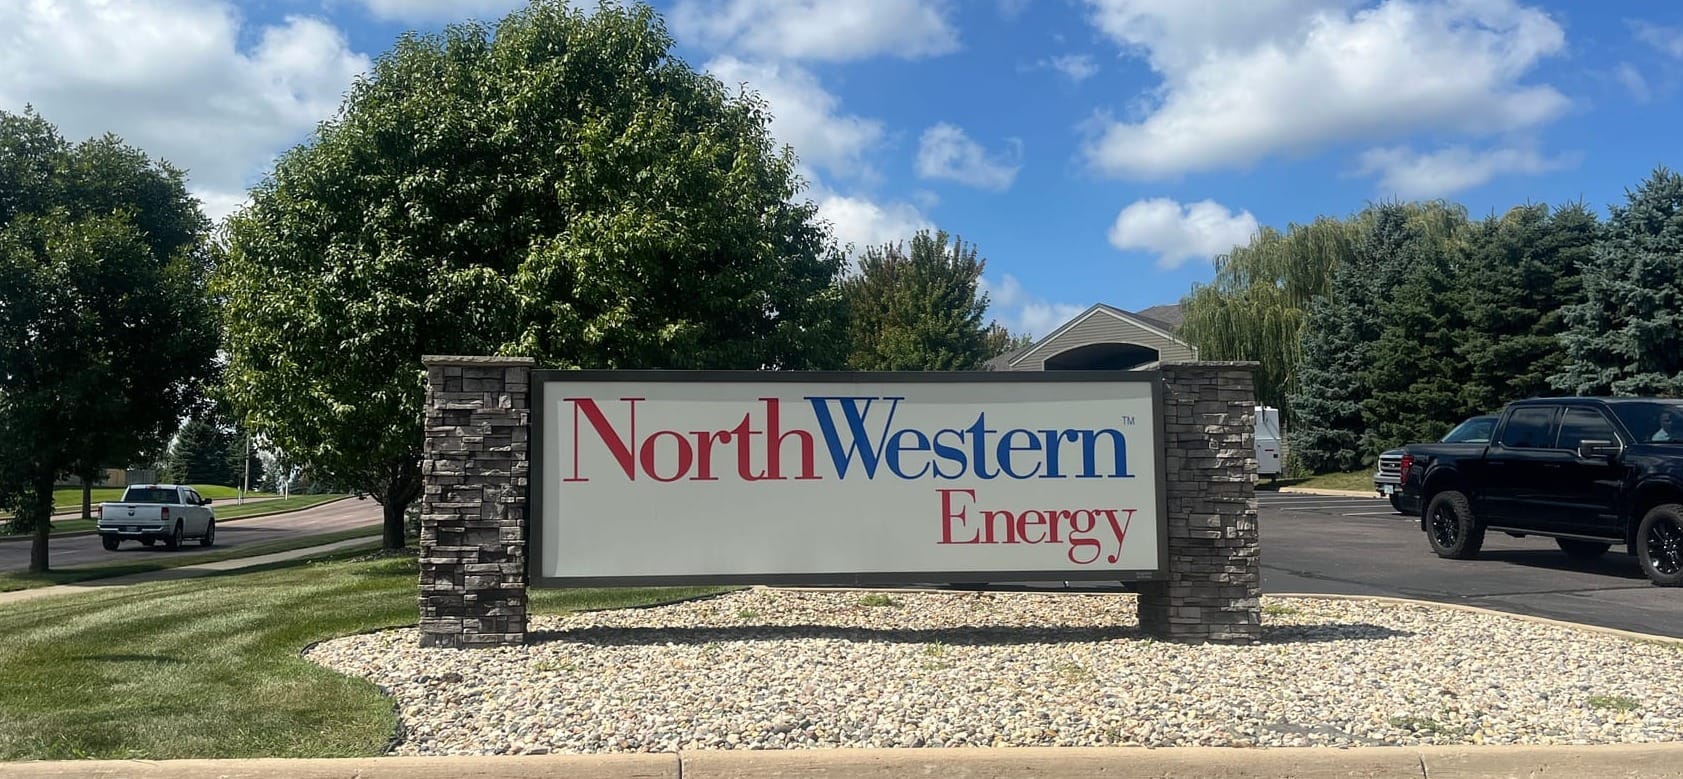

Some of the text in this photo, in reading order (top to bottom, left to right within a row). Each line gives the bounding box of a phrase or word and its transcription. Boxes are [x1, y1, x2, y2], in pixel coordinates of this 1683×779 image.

[563, 397, 1135, 481] NorthWestern TM
[937, 489, 1136, 564] Energy
